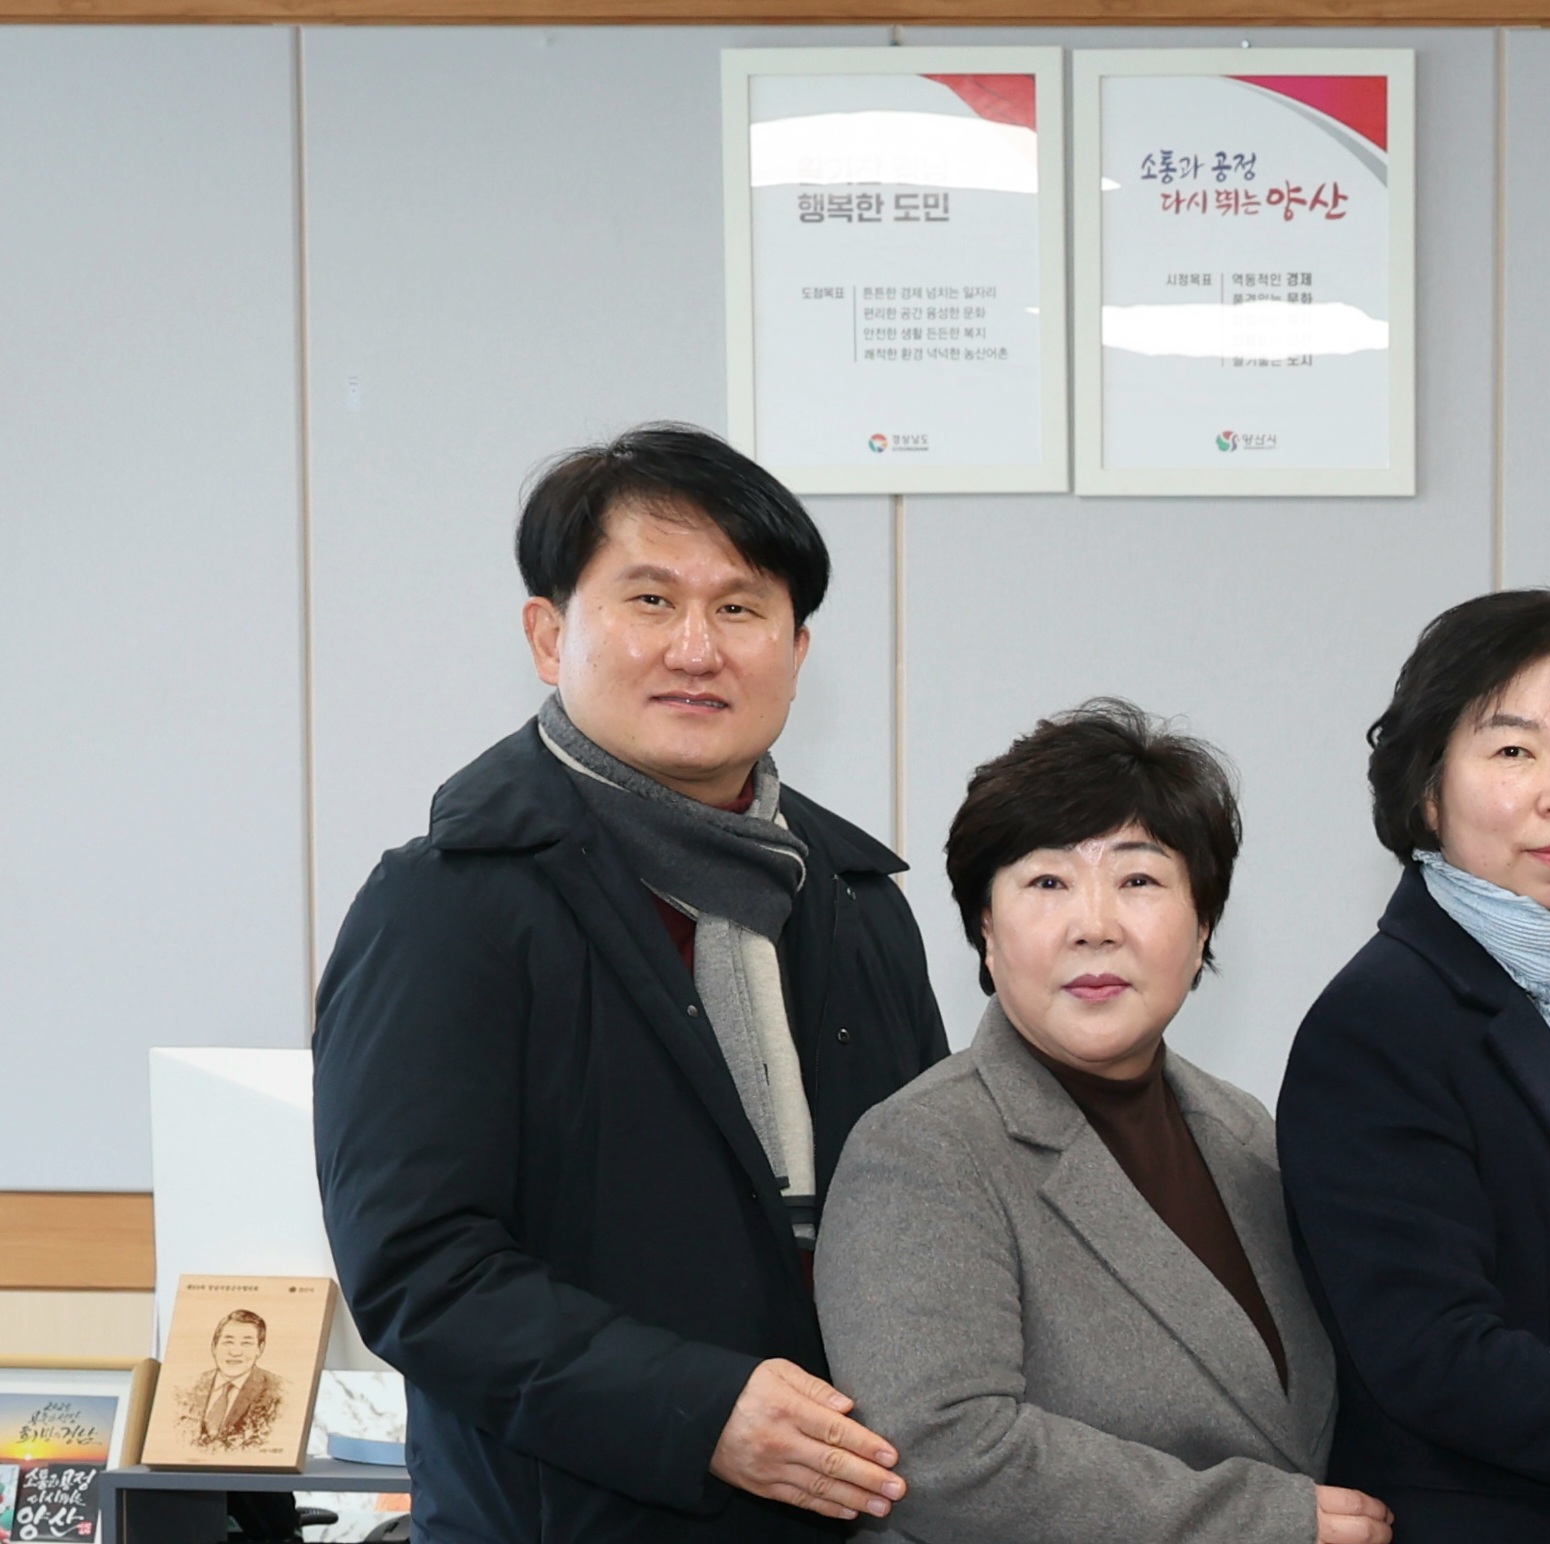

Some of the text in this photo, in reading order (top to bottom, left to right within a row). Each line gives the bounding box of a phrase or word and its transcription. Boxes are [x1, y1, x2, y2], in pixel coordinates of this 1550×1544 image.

[1141, 149, 1256, 184] 소통과 공정
[797, 192, 950, 223] 행복한 도민
[1160, 189, 1208, 215] 다시
[1266, 180, 1349, 222] 양산
[1166, 273, 1212, 286] 시정목표
[1231, 272, 1313, 287] 역동적인 경제
[900, 286, 923, 299] 경제
[926, 286, 959, 299] 넘치는
[962, 286, 997, 299] 일자리
[863, 307, 897, 321] 편리한
[900, 307, 923, 320] 공간
[963, 306, 986, 319] 문화
[863, 327, 987, 341] 안전한 생활 든든한 복지
[927, 348, 961, 361] 넉넉한
[17, 1505, 84, 1540] 양산
